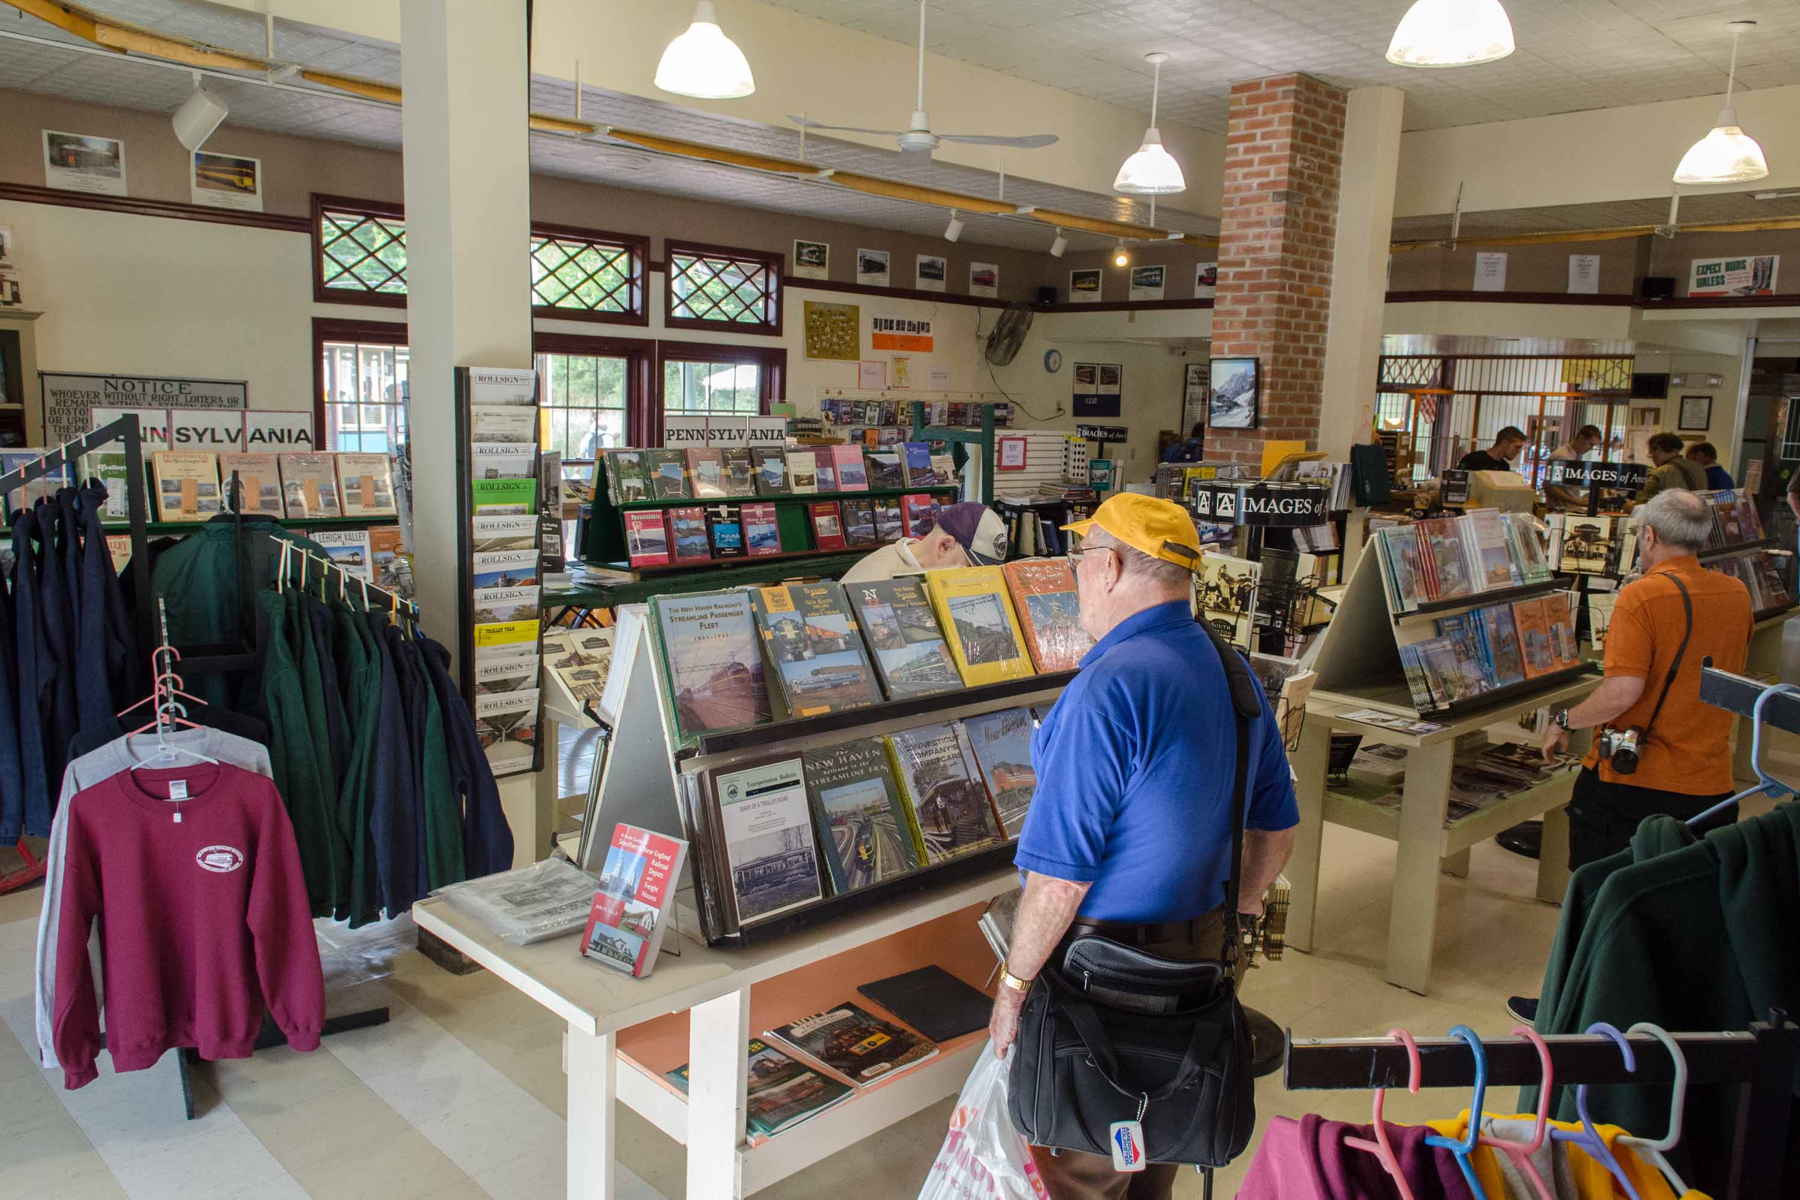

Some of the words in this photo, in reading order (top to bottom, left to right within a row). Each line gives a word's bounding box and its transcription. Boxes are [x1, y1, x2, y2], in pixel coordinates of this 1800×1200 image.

[478, 375, 519, 384] ROLLSIGN
[104, 379, 192, 394] NOTICE
[50, 388, 100, 399] WHOEVER
[105, 391, 147, 401] WITHOUT
[49, 407, 87, 416] BOSTO
[67, 416, 88, 424] UPO
[666, 429, 784, 440] PENNSYLVANIA
[479, 447, 519, 455] ROLLSIGN
[1565, 467, 1617, 481] IMAGES
[1620, 471, 1630, 485] of
[480, 482, 520, 491] ROLLSIGN
[1241, 496, 1312, 514] IMAGES
[1314, 497, 1325, 516] of
[481, 553, 521, 565] ROLLSIGN
[483, 591, 523, 601] ROLLSIGN
[699, 622, 719, 631] FLEET
[483, 663, 523, 675] ROLLSIGN
[805, 758, 834, 770] NEW
[839, 750, 881, 764] HAVEN
